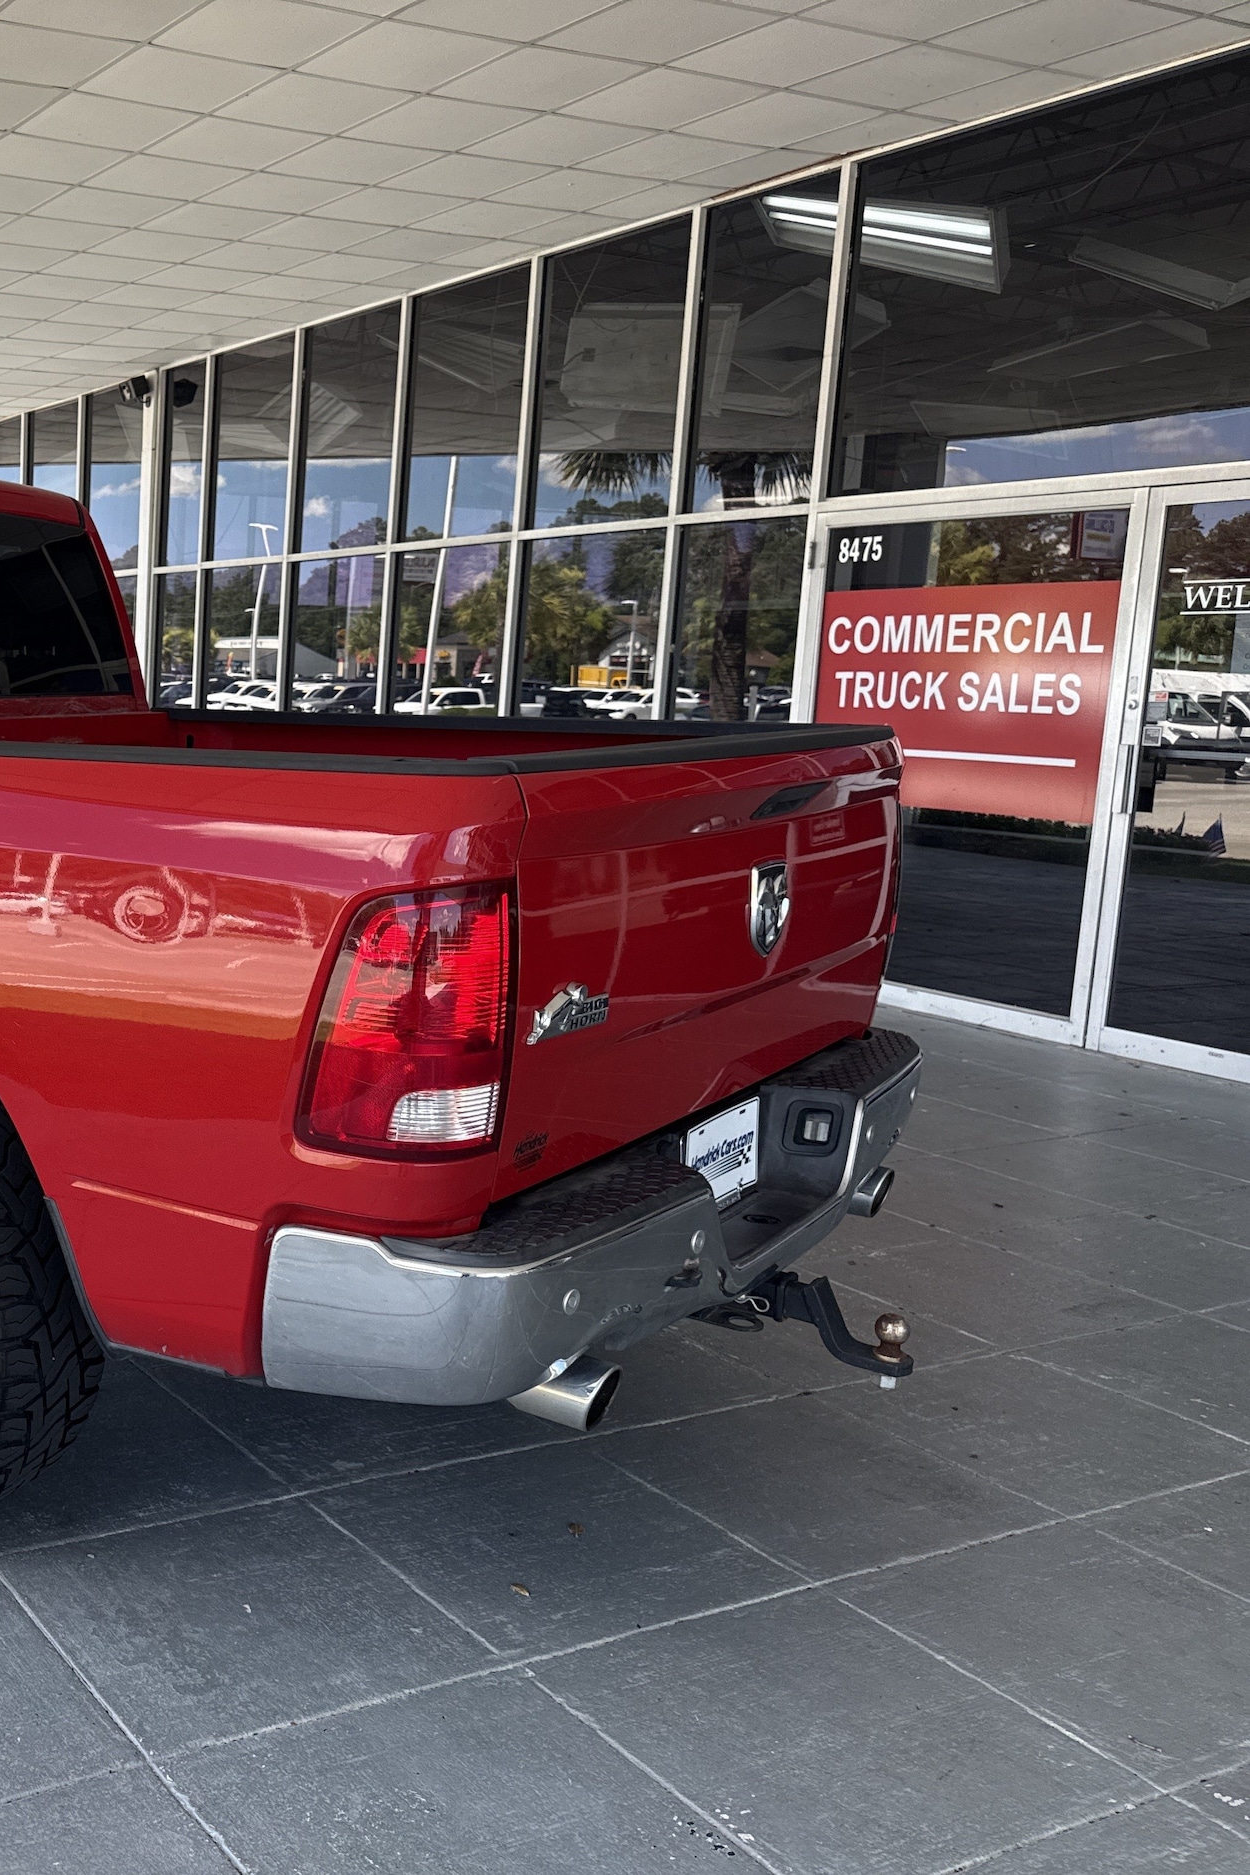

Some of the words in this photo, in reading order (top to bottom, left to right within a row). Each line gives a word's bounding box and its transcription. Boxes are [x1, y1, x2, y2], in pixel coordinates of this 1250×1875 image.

[838, 535, 883, 564] 8475
[827, 611, 1104, 656] COMMERCIAL
[835, 670, 948, 711] TRUCK
[956, 672, 1083, 716] SALES
[570, 1010, 607, 1030] HORN
